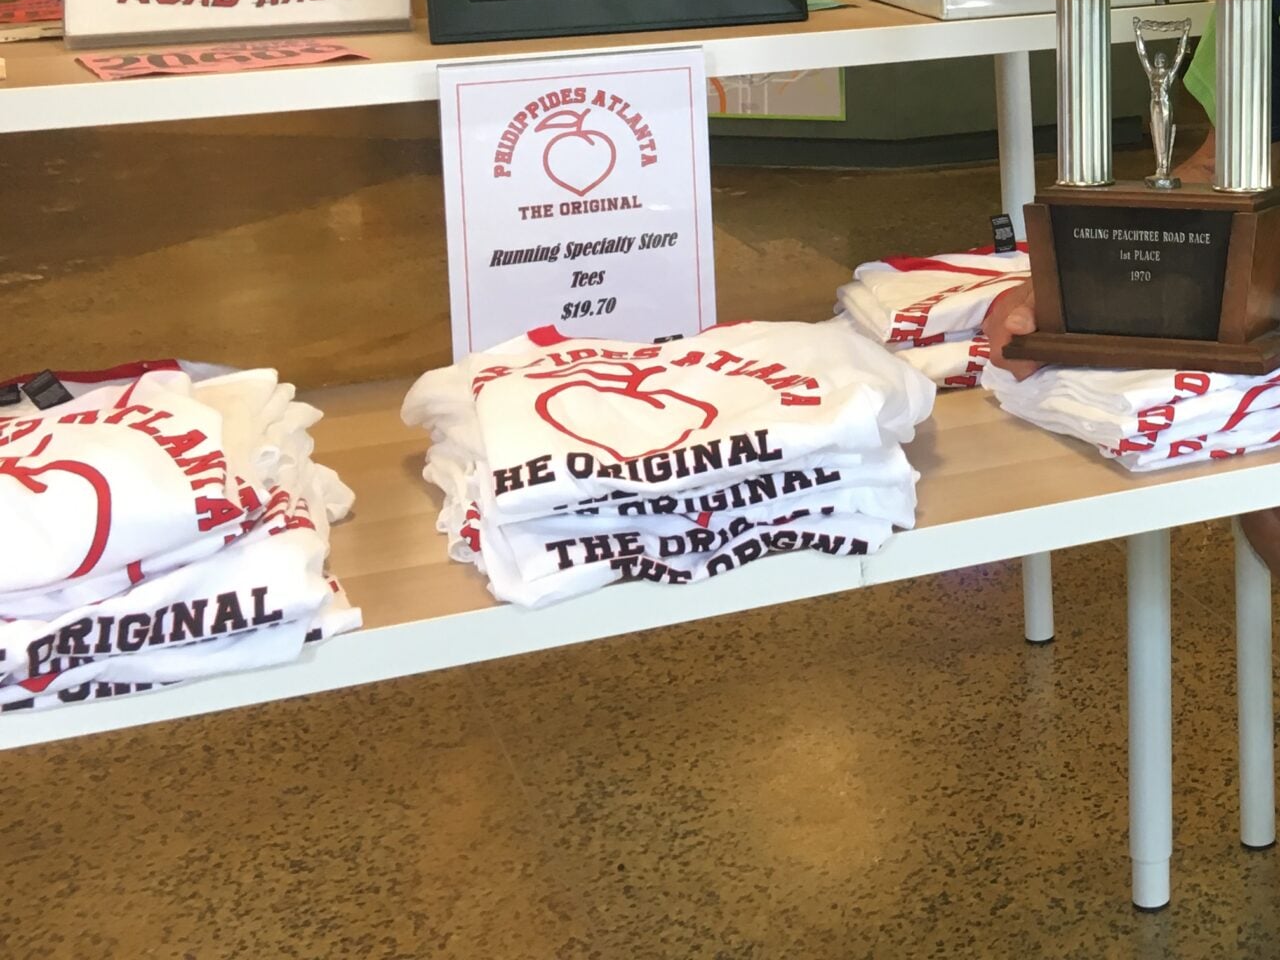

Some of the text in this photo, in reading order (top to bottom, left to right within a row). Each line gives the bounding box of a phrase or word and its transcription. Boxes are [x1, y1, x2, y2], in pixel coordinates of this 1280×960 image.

[494, 87, 658, 178] PHIDIPPIDES ATLANTA
[518, 195, 642, 220] THE ORIGINAL
[1073, 228, 1211, 245] CARLING PEACHTREE ROAD RACE
[489, 231, 679, 268] Running Specialty Store
[1120, 249, 1161, 262] 1st PLACE
[571, 269, 606, 289] Tees
[1130, 270, 1151, 282] 1970
[561, 296, 617, 321] $19.70
[493, 454, 556, 496] HE
[545, 531, 646, 571] THE
